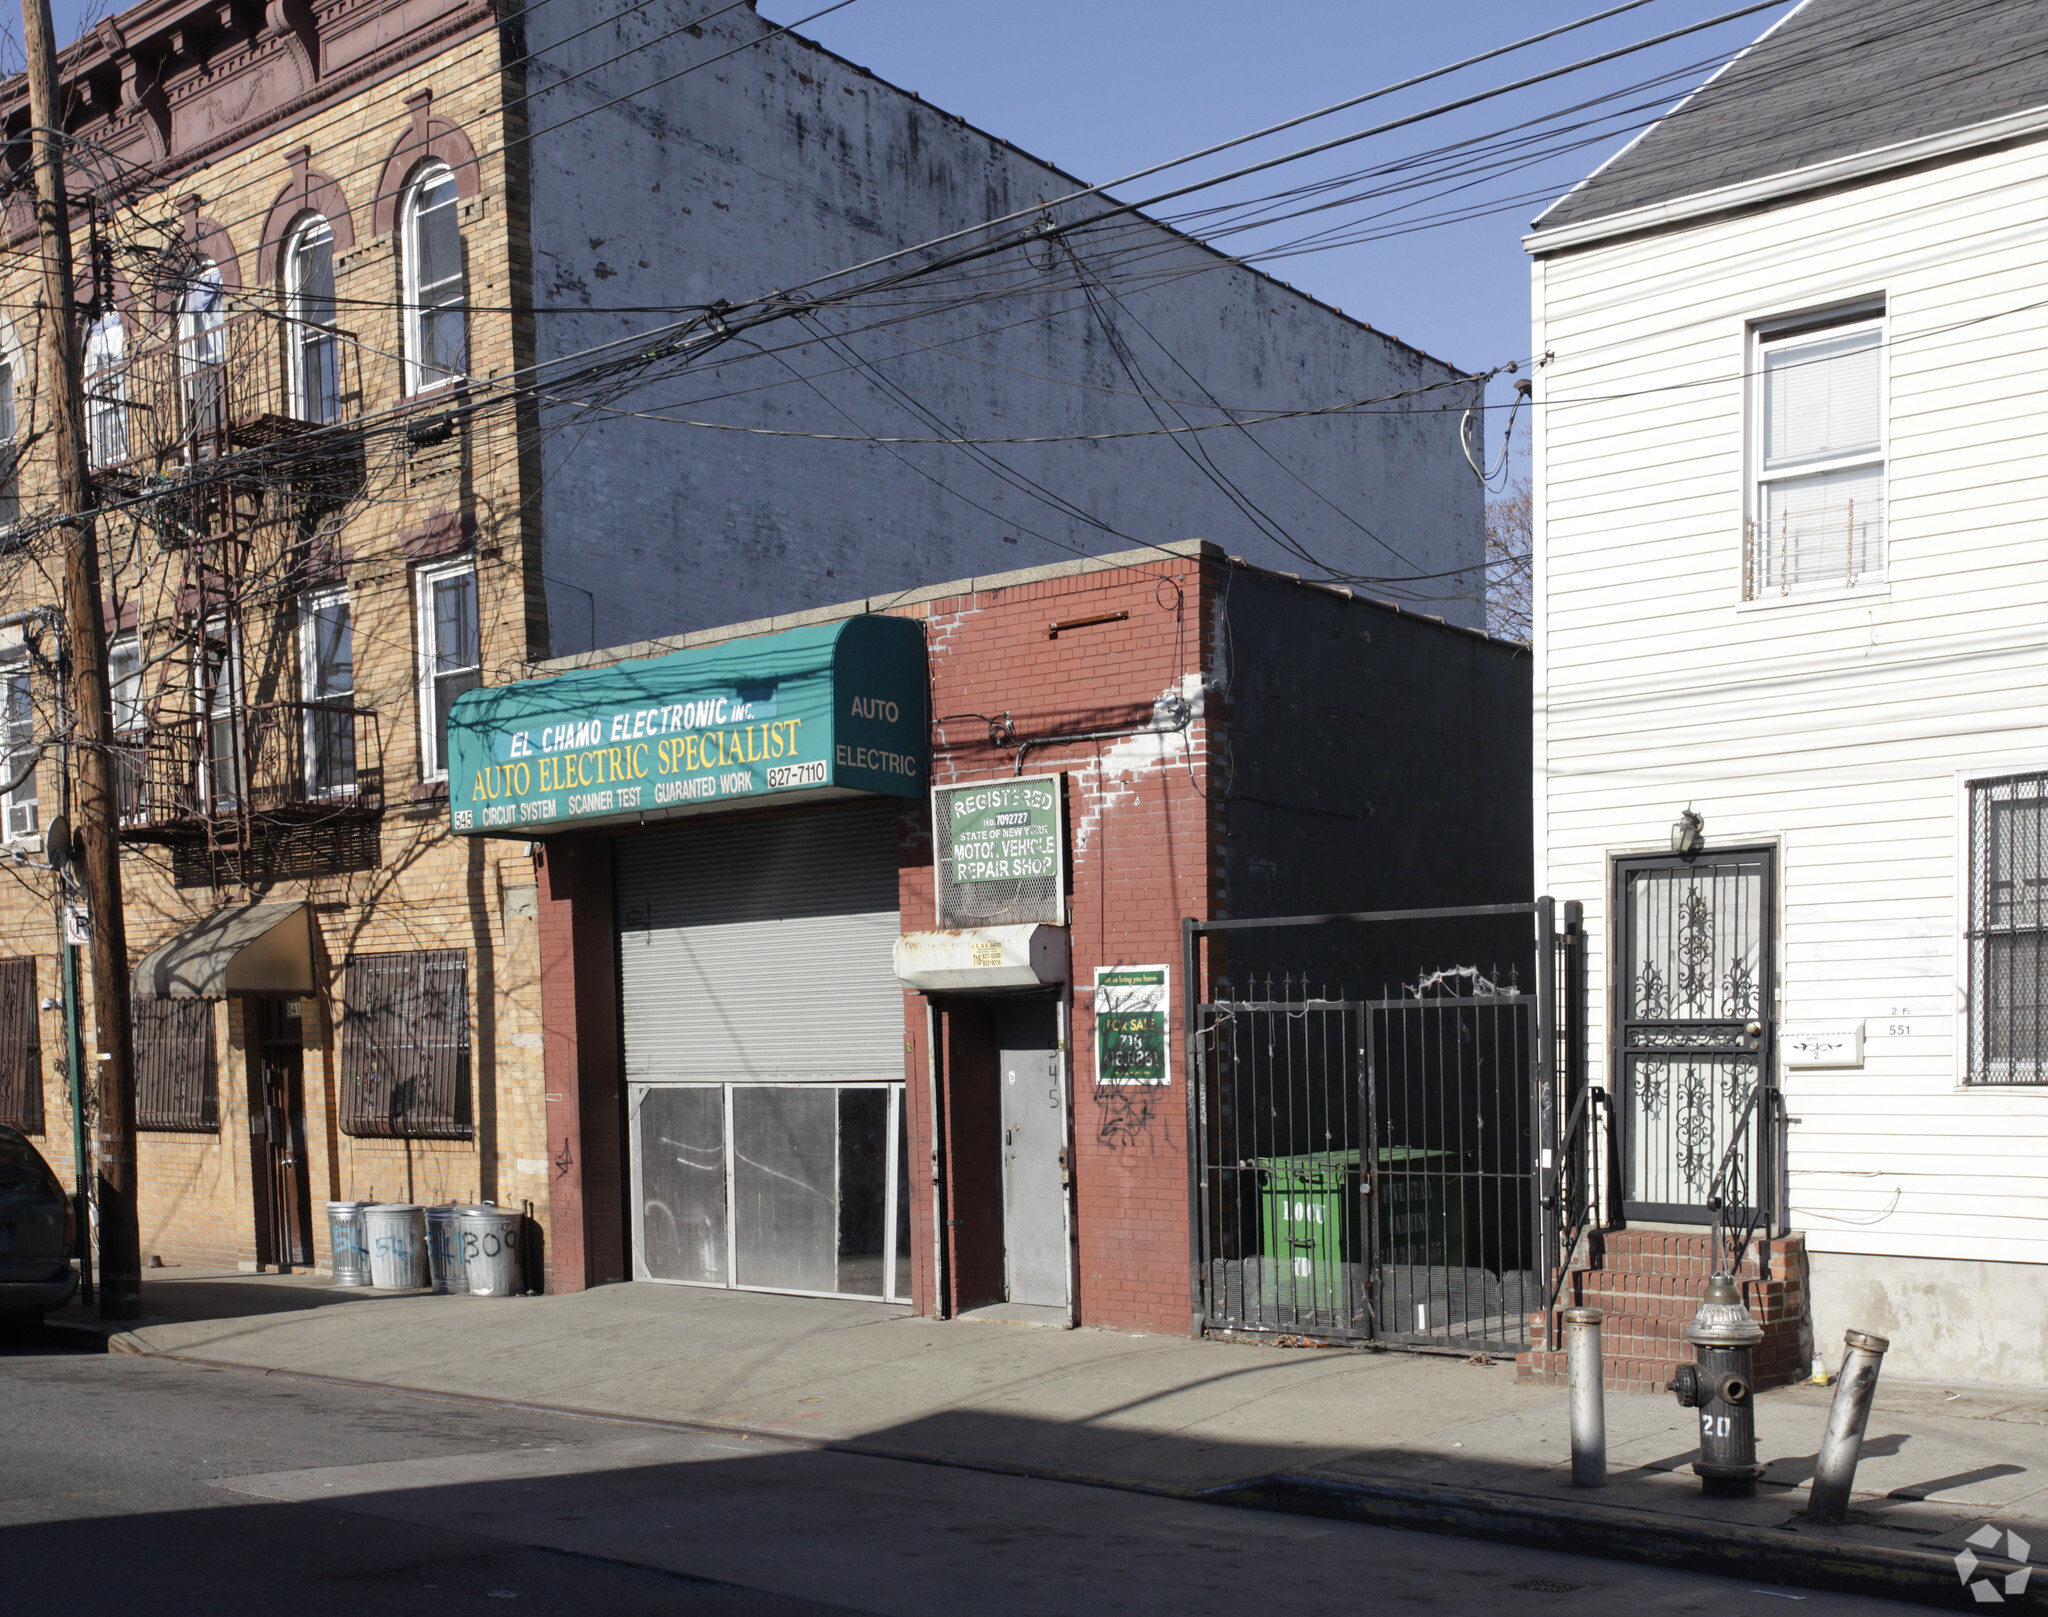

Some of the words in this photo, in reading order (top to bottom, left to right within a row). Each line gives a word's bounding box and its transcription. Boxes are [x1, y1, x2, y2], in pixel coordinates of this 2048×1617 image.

[851, 695, 899, 723] AUTO
[510, 731, 533, 758] EL
[542, 719, 601, 752] CHAMO
[610, 697, 728, 742] ELECTRONIC
[731, 703, 755, 722] INC.
[472, 762, 531, 801] AUTO
[538, 743, 649, 792] ELECTRIC
[658, 718, 802, 775] SPECIALIST
[836, 744, 916, 777] ELECTRIC
[768, 763, 825, 787] 827-7110
[482, 804, 517, 827] CIRCUIT
[520, 799, 557, 821] SYSTEM
[568, 790, 614, 815] SCANNER
[616, 786, 642, 808] TEST
[654, 776, 716, 804] GUARANTED
[719, 771, 753, 794] WORK
[954, 789, 1053, 819] REGISTERED
[455, 812, 473, 829] 545
[983, 818, 996, 827] No.
[960, 830, 988, 842] STATE
[989, 829, 1000, 839] OF
[1002, 827, 1023, 838] NEW
[1023, 824, 1049, 836] YORK
[954, 841, 1000, 861] MOTOR
[1001, 836, 1055, 857] VEHICLE
[957, 860, 1010, 880] REPAIR
[1012, 856, 1052, 876] SHOP
[1119, 975, 1132, 985] bring
[1141, 992, 1166, 1002] GROUP
[1120, 1034, 1143, 1050] 718
[1889, 1025, 1910, 1036] 551
[1814, 1051, 1819, 1060] 2
[1382, 1182, 1405, 1204] FVE
[1702, 1414, 1731, 1437] 20
